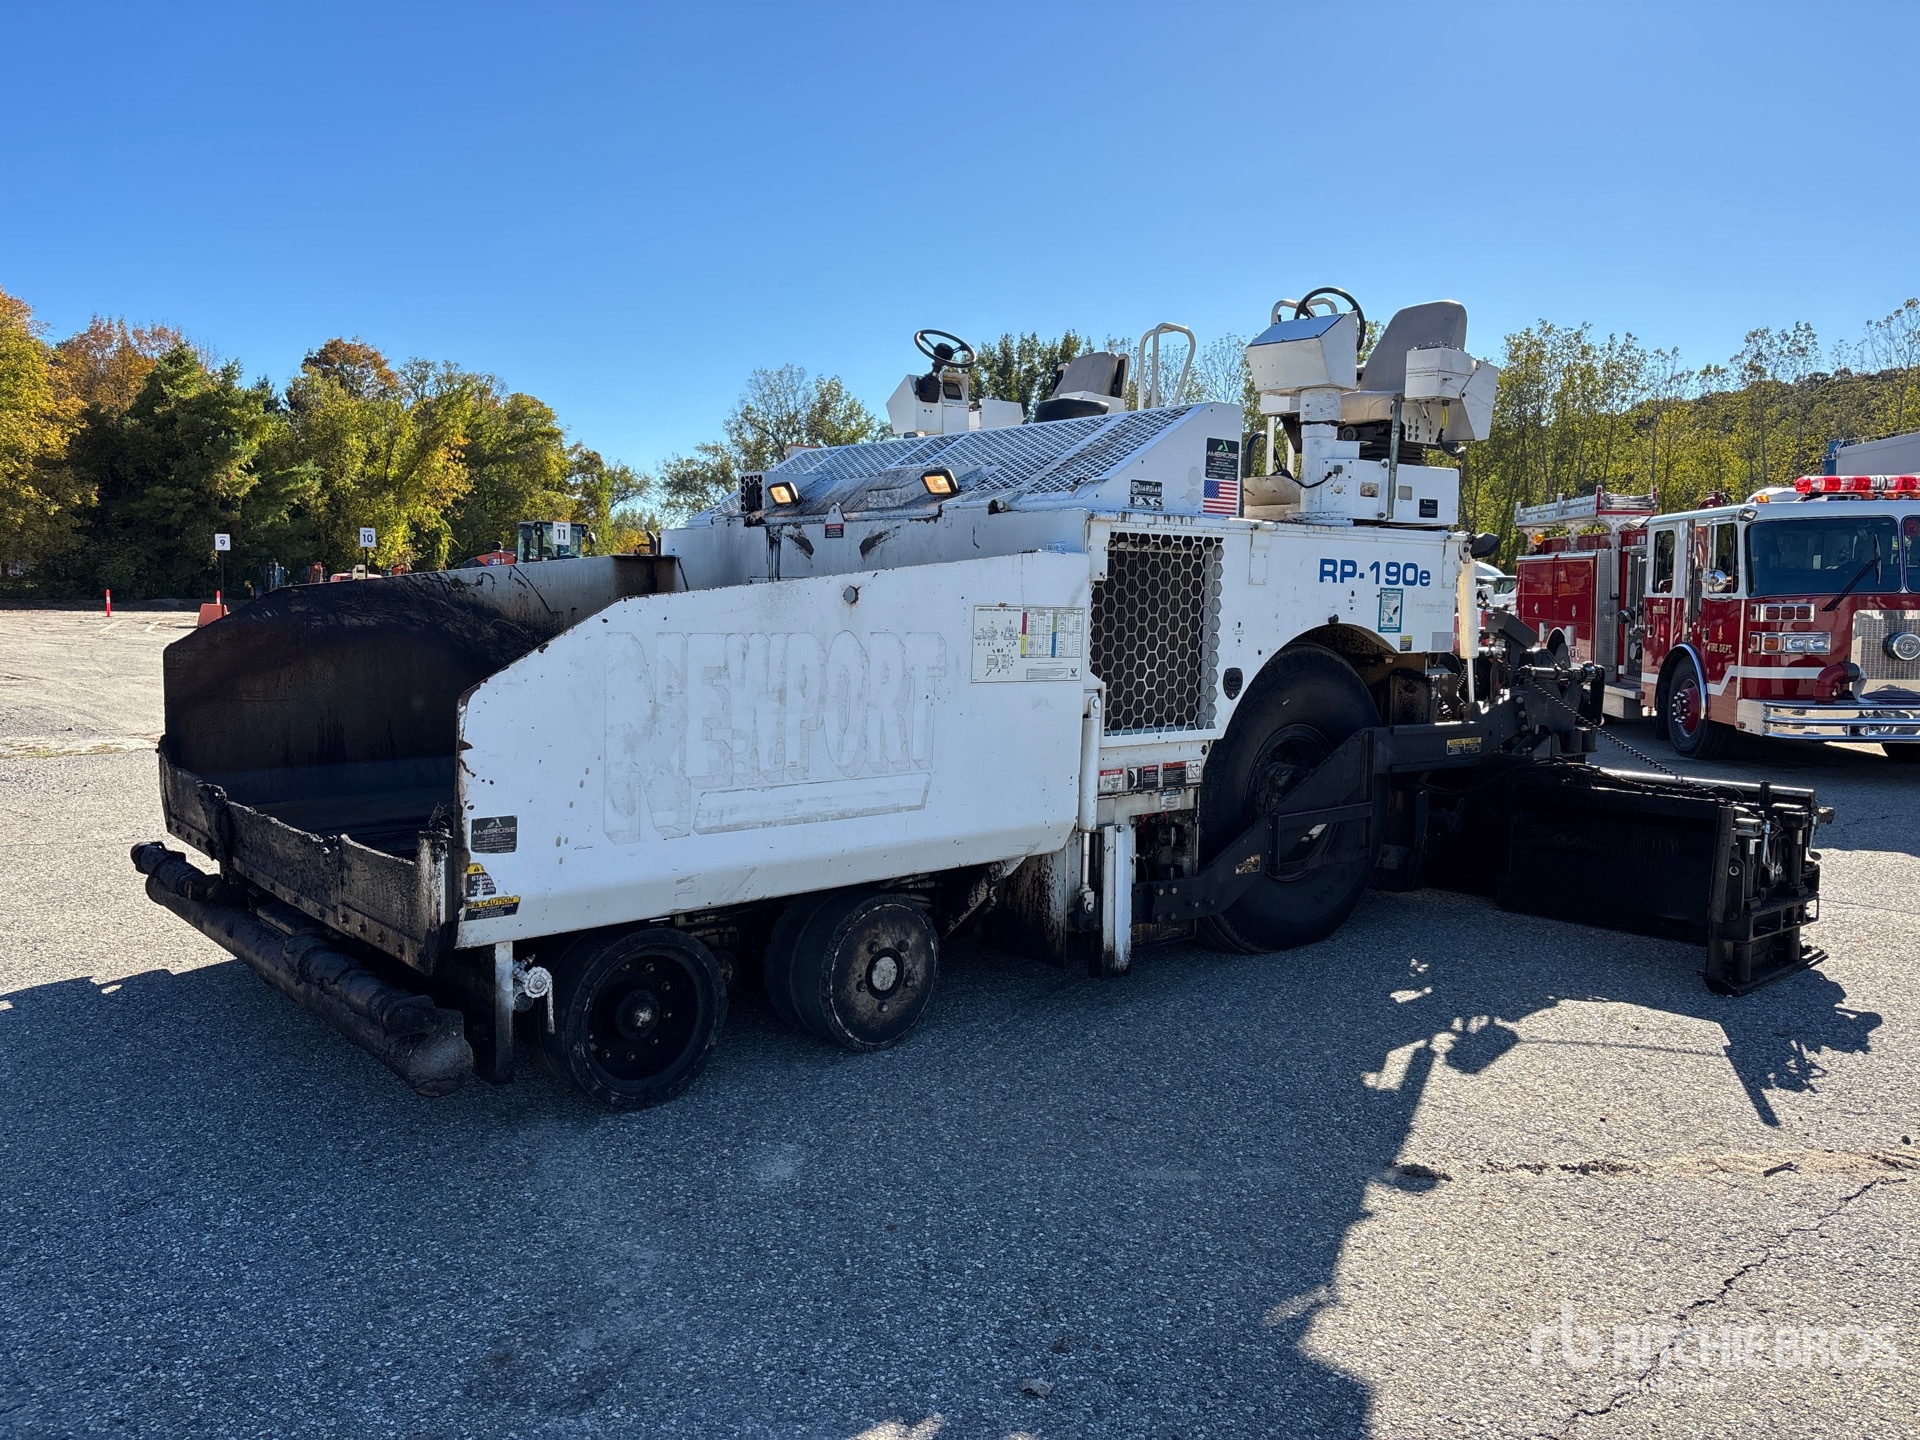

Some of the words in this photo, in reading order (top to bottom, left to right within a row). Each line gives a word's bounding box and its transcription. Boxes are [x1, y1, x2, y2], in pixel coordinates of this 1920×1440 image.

[1207, 450, 1238, 460] AMBROSE
[1131, 482, 1162, 494] GUARDIAN
[362, 533, 374, 543] 10
[557, 529, 566, 540] 11
[219, 538, 226, 547] 9
[1319, 558, 1431, 587] RP-190e
[1708, 642, 1718, 652] FIRE
[472, 826, 517, 836] AMBROSE
[481, 897, 514, 907] CAUTION
